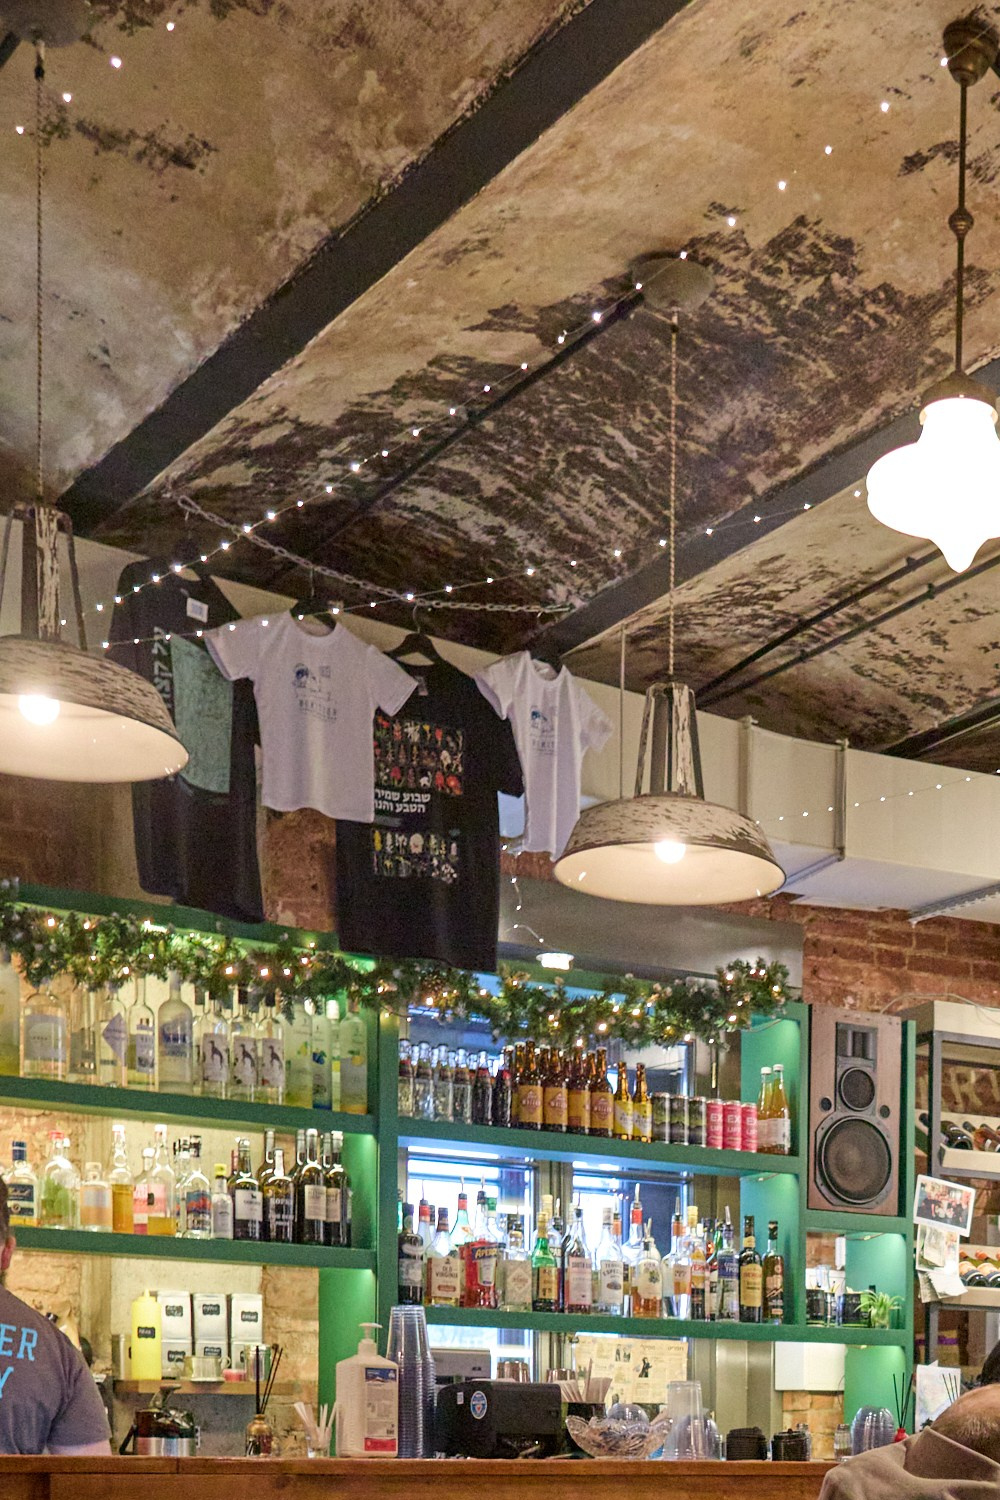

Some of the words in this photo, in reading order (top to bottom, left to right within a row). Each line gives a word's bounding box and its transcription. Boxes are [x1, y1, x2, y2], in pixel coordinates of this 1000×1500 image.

[374, 788, 400, 801] שמיר
[402, 792, 431, 803] שבוע
[374, 800, 394, 811] והנו
[395, 802, 426, 813] הטבע
